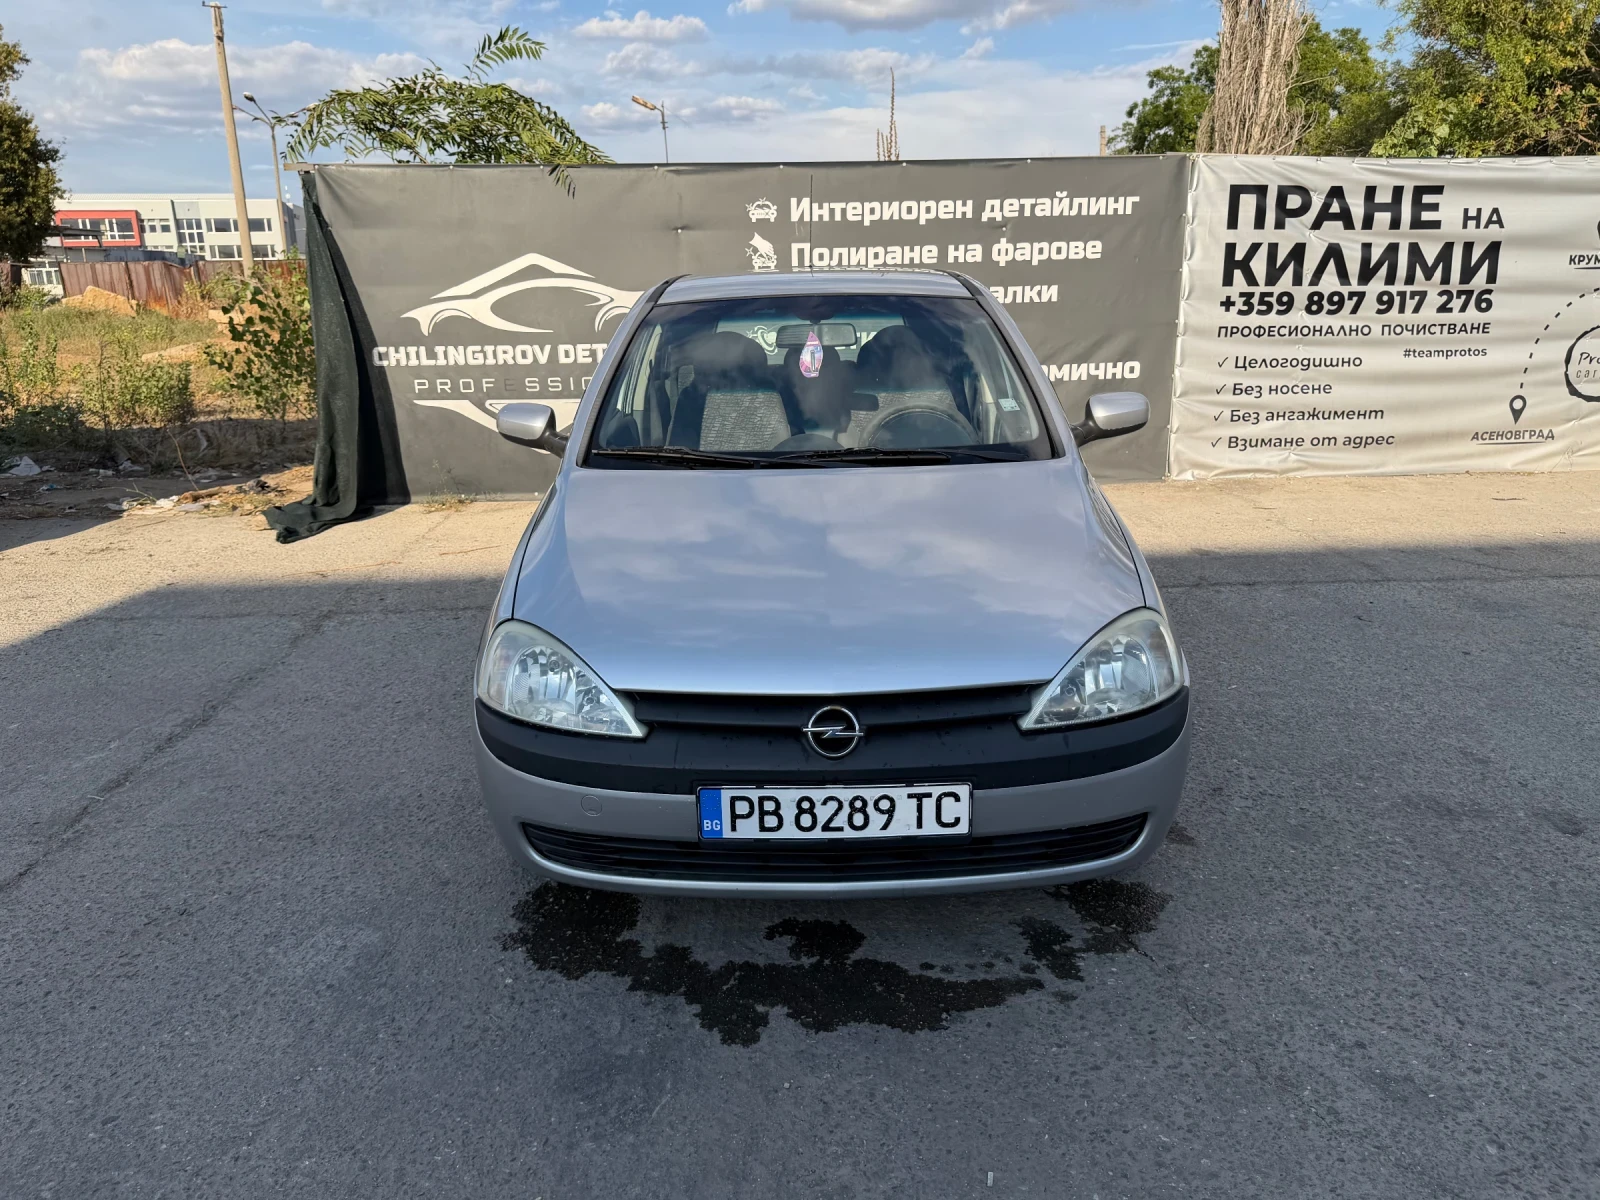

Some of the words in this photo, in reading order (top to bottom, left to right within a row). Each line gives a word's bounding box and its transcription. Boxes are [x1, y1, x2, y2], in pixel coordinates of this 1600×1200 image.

[790, 197, 973, 226] Интериорен
[981, 191, 1140, 222] детайлинг
[1226, 184, 1445, 230] ПРАНЕ
[1462, 207, 1505, 230] НА
[791, 242, 938, 267] Полиране
[947, 243, 982, 263] на
[991, 238, 1102, 266] фарове
[1222, 240, 1502, 287] КИЛИМИ
[1219, 291, 1295, 316] +359
[1304, 291, 1367, 316] 897
[1375, 290, 1428, 315] 917
[1435, 288, 1494, 314] 276
[1217, 324, 1372, 339] ПРОФЕСИОНАЛНО
[1381, 322, 1491, 336] ПОЧИСТВАНЕ
[372, 344, 551, 366] CHILINGIROV
[557, 343, 608, 365] DET
[1403, 347, 1487, 360] #teamprotos
[1234, 355, 1363, 371] Целогодишно
[1232, 382, 1263, 398] Без
[1268, 382, 1333, 396] носене
[1229, 409, 1260, 425] Без
[1265, 407, 1385, 422] ангажимент
[1227, 435, 1305, 451] Взимане
[1310, 436, 1337, 448] от
[1342, 434, 1395, 449] адрес
[1470, 428, 1555, 441] АСЕНОВГРАД
[729, 794, 784, 832] PB
[794, 793, 897, 832] 8289
[906, 790, 961, 830] TC
[703, 819, 721, 831] BG
